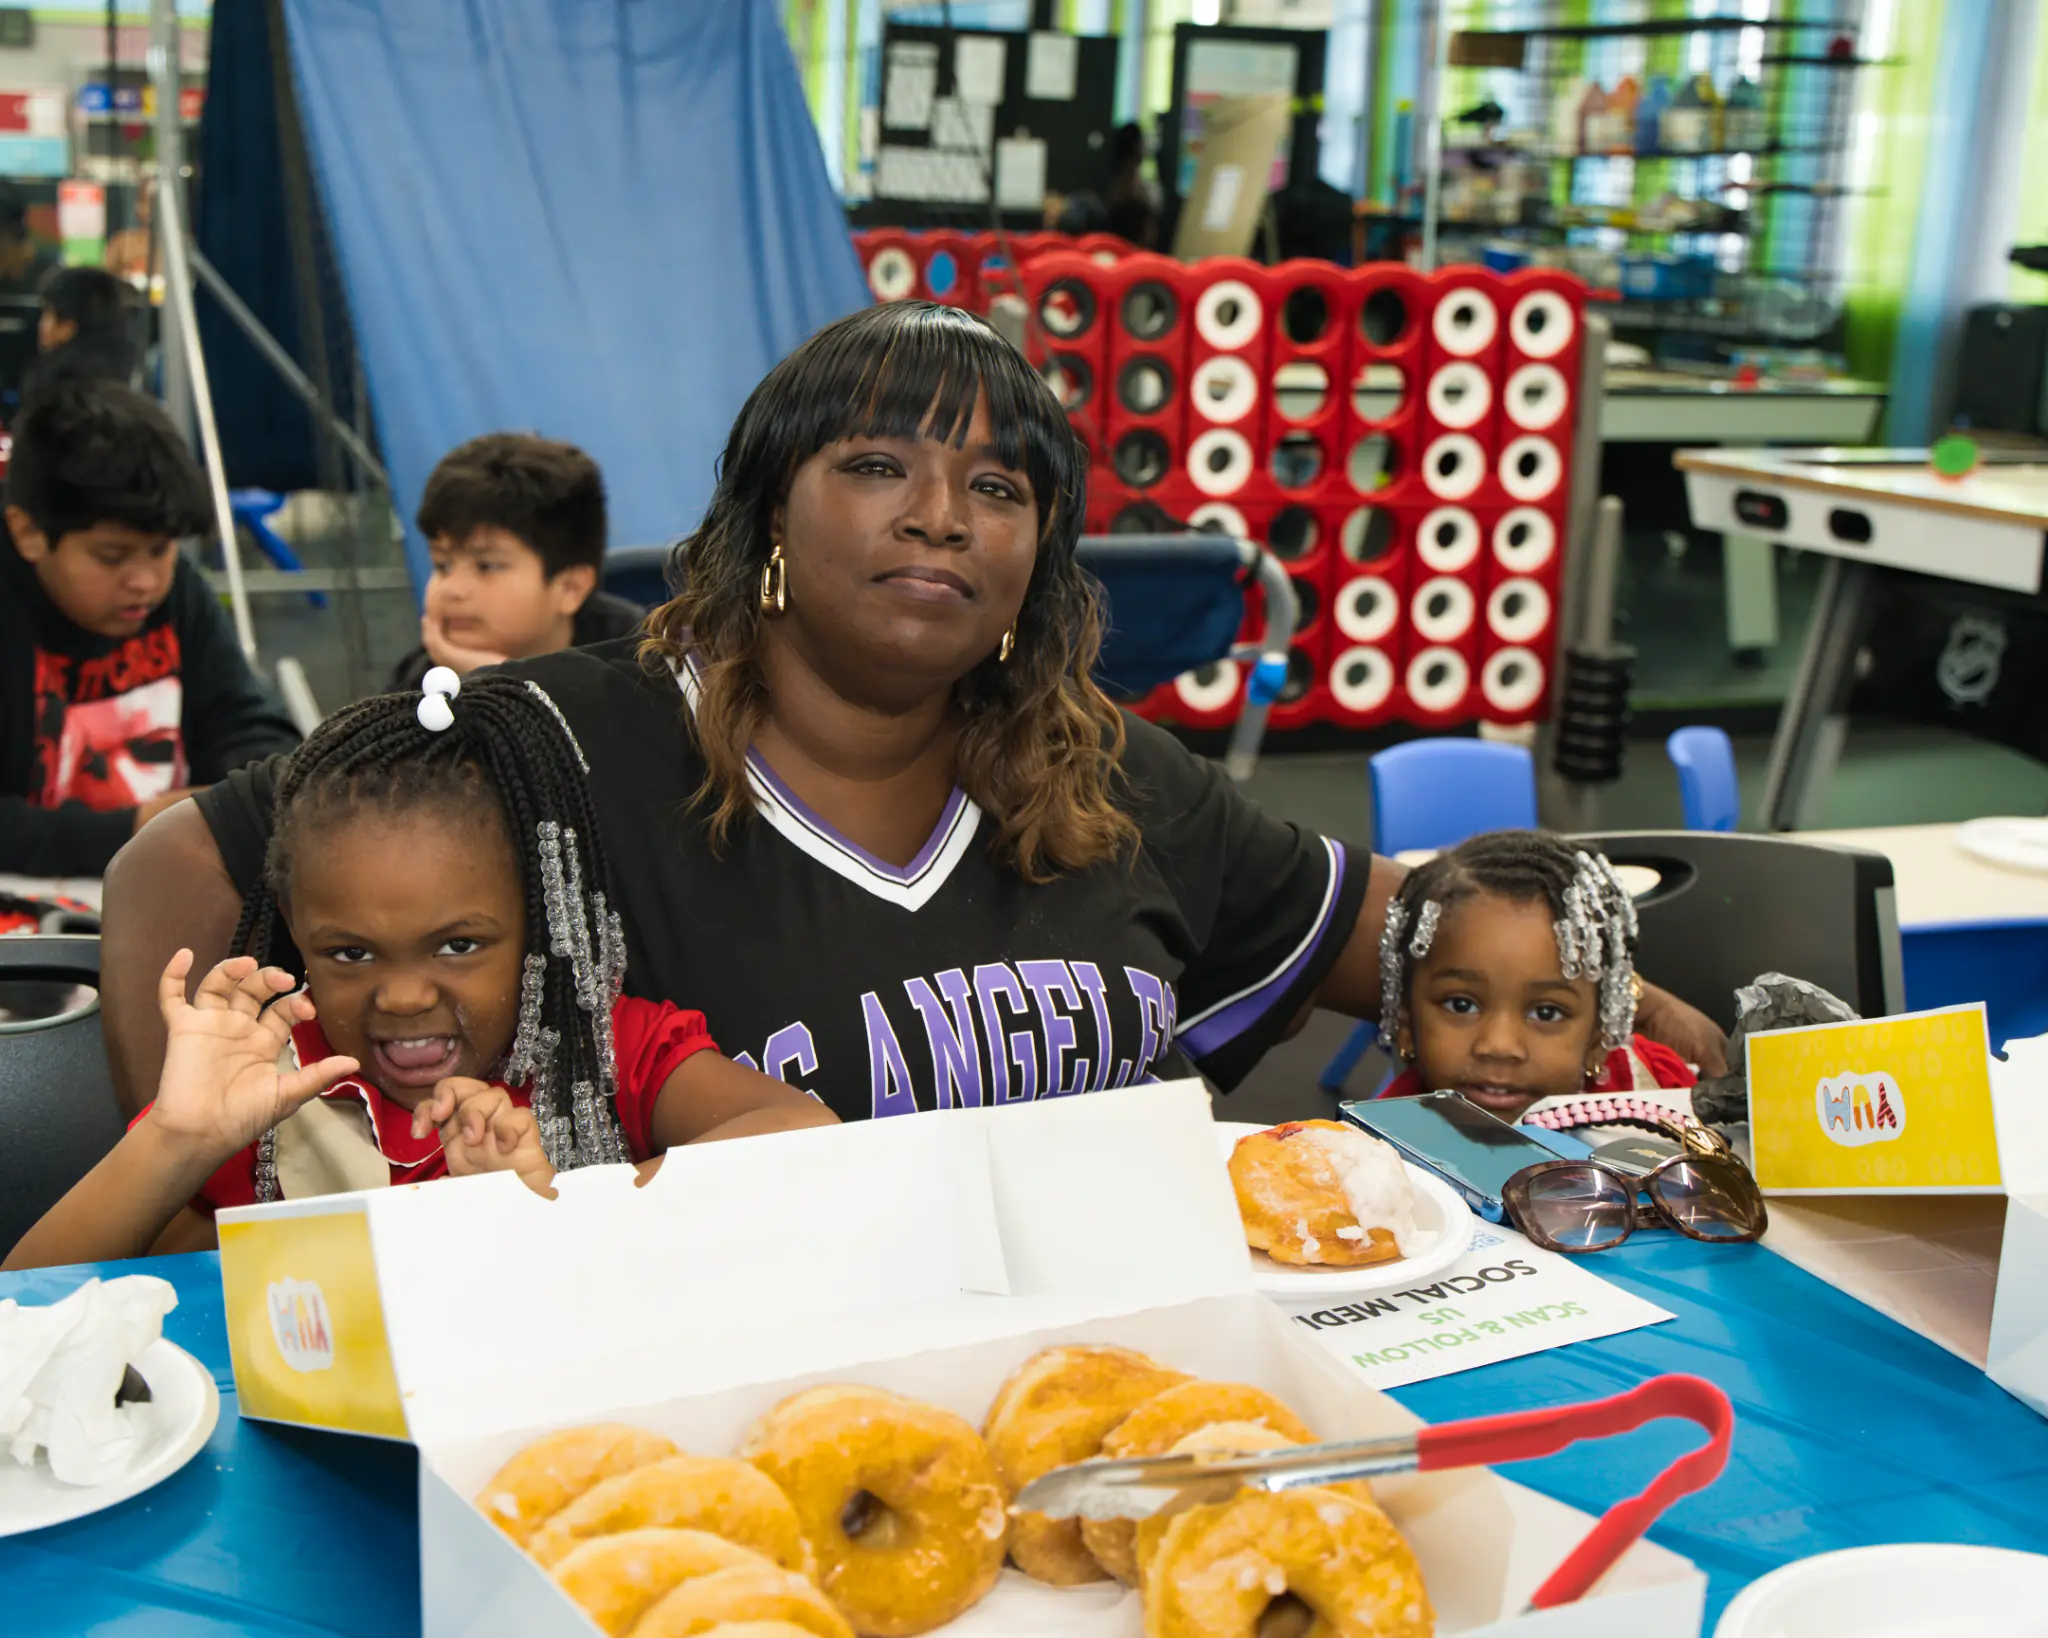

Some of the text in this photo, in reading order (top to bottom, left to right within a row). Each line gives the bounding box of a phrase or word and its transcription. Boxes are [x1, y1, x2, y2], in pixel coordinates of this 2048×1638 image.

[1291, 1259, 1537, 1331] SOCIAL MEDI
[1418, 1307, 1466, 1326] US
[1353, 1301, 1588, 1369] SCAN & FOLLOW
